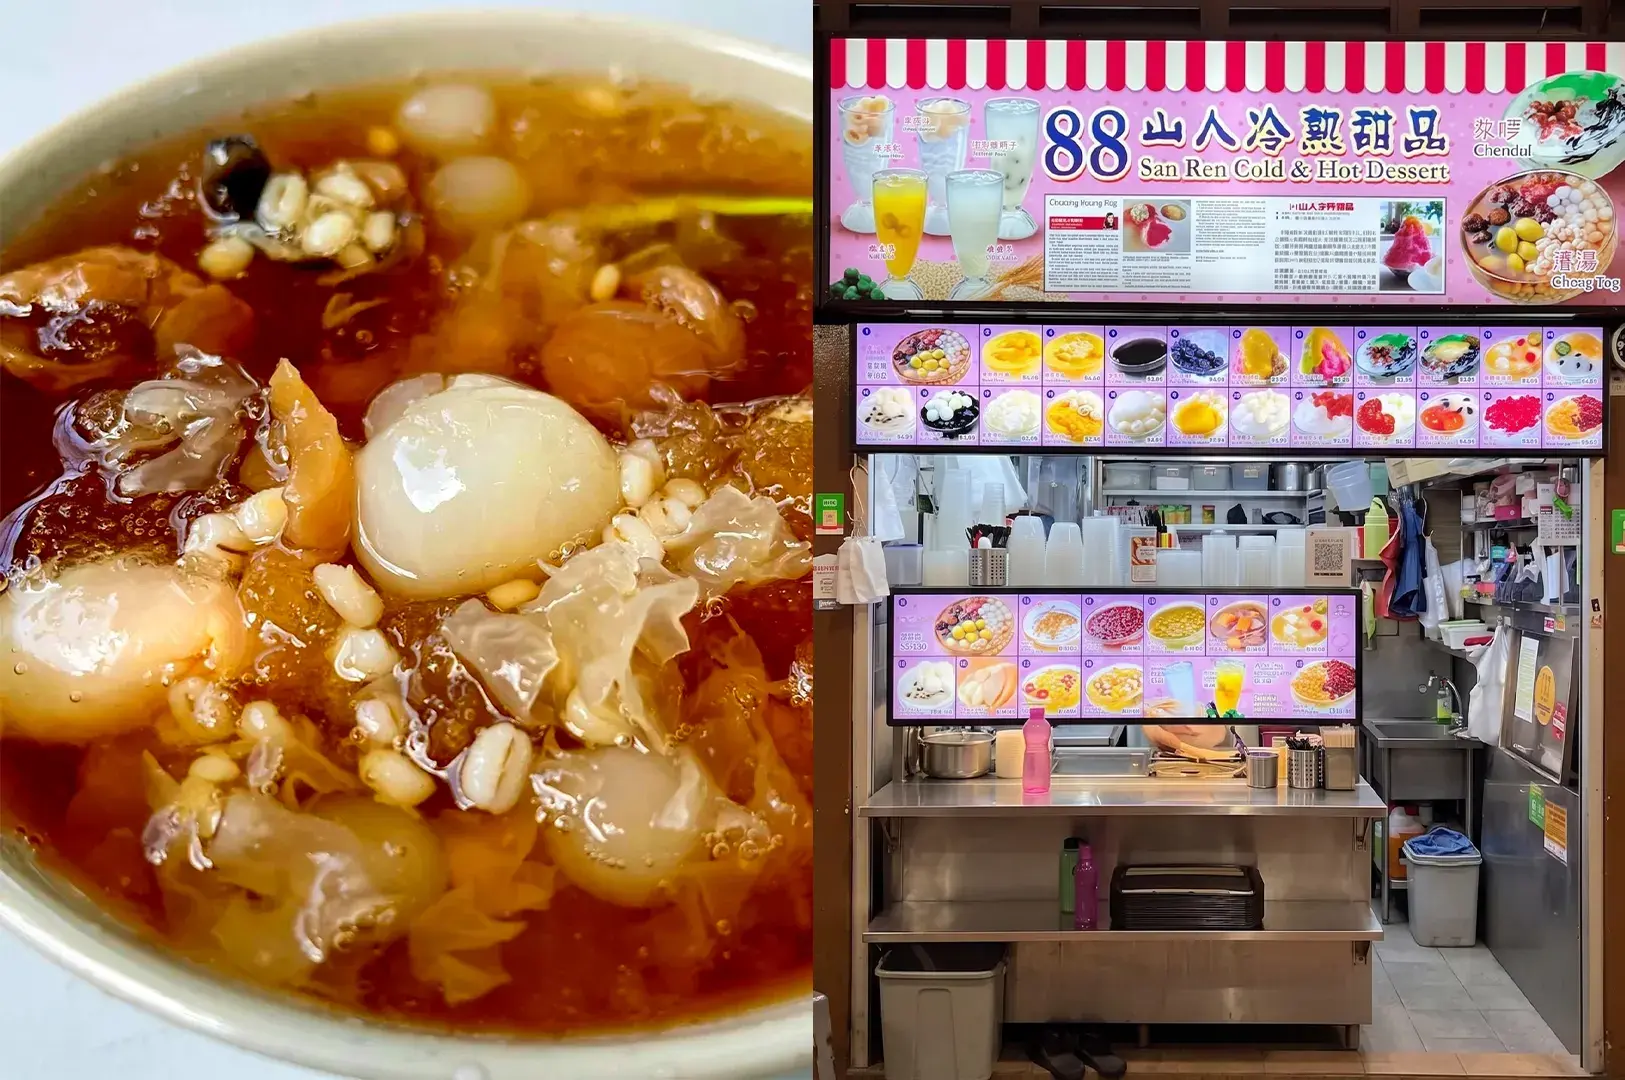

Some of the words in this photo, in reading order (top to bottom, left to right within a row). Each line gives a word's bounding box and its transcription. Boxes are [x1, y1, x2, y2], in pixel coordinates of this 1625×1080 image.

[1044, 109, 1128, 177] 88
[1141, 106, 1446, 153] 山人冷熱甜品
[1140, 157, 1178, 178] San
[1185, 158, 1227, 178] Ren
[1234, 158, 1284, 179] Cold
[1291, 160, 1313, 179] &
[1317, 160, 1360, 179] Hot
[1365, 160, 1448, 180] Dessert
